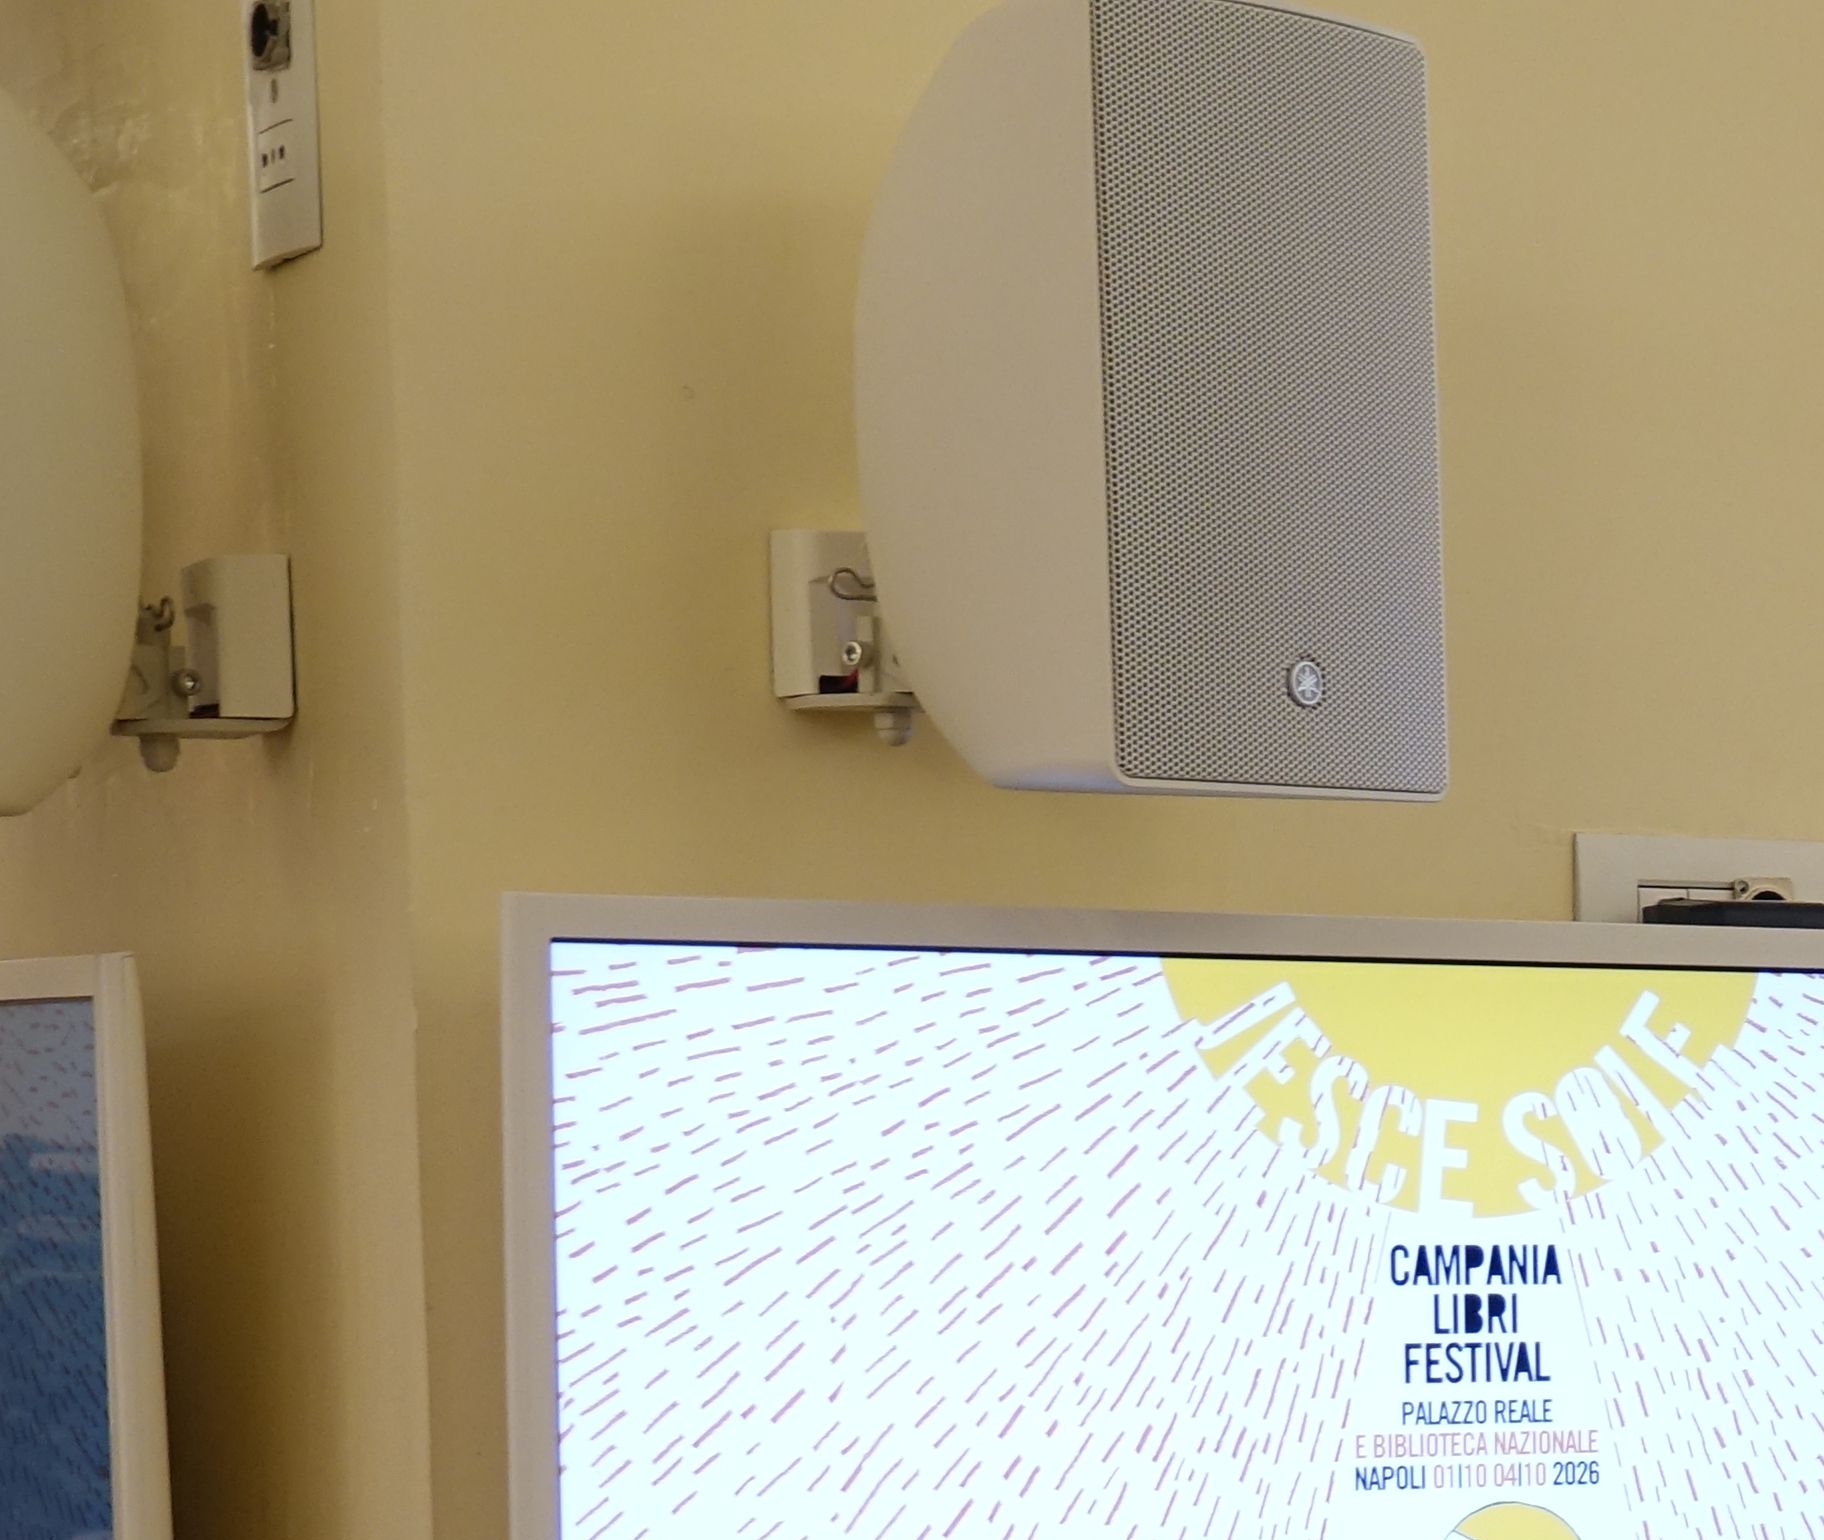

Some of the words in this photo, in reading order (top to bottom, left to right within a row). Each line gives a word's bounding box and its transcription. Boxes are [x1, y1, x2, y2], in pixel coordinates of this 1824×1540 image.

[1391, 1245, 1562, 1285] CAMPANIA
[1434, 1294, 1518, 1334] LIBRI
[1405, 1342, 1550, 1383] FESTIVAL
[1402, 1401, 1487, 1425] PALAZZO
[1495, 1399, 1553, 1423] REALE
[1356, 1435, 1366, 1458] E
[1374, 1432, 1488, 1458] BIBLIOTECA
[1495, 1430, 1599, 1455] NAZIONALE
[1355, 1465, 1425, 1491] NAPOLI
[1553, 1461, 1600, 1485] 2026
